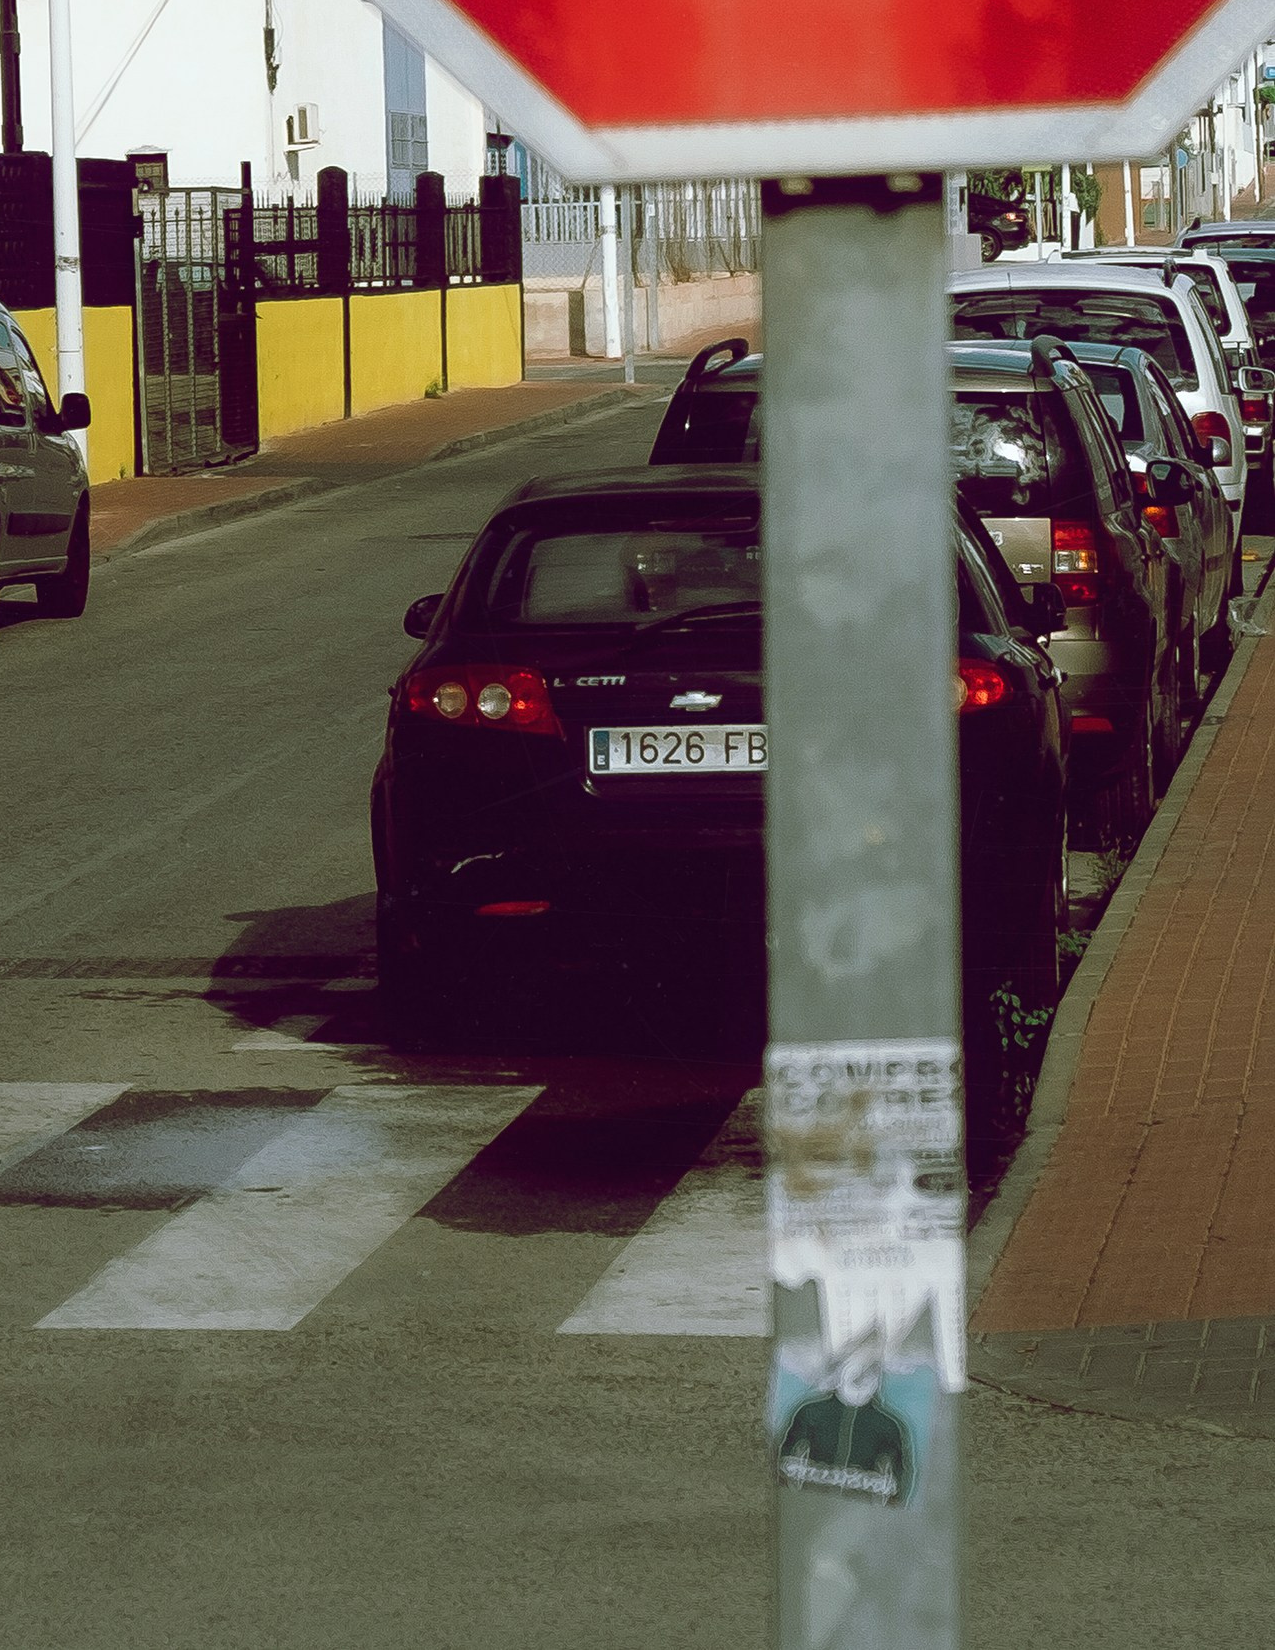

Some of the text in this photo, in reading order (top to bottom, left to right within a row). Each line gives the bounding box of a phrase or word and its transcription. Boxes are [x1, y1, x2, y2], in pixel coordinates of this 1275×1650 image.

[553, 675, 626, 688] LCETTI
[620, 731, 705, 765] 1626
[724, 731, 768, 765] FB
